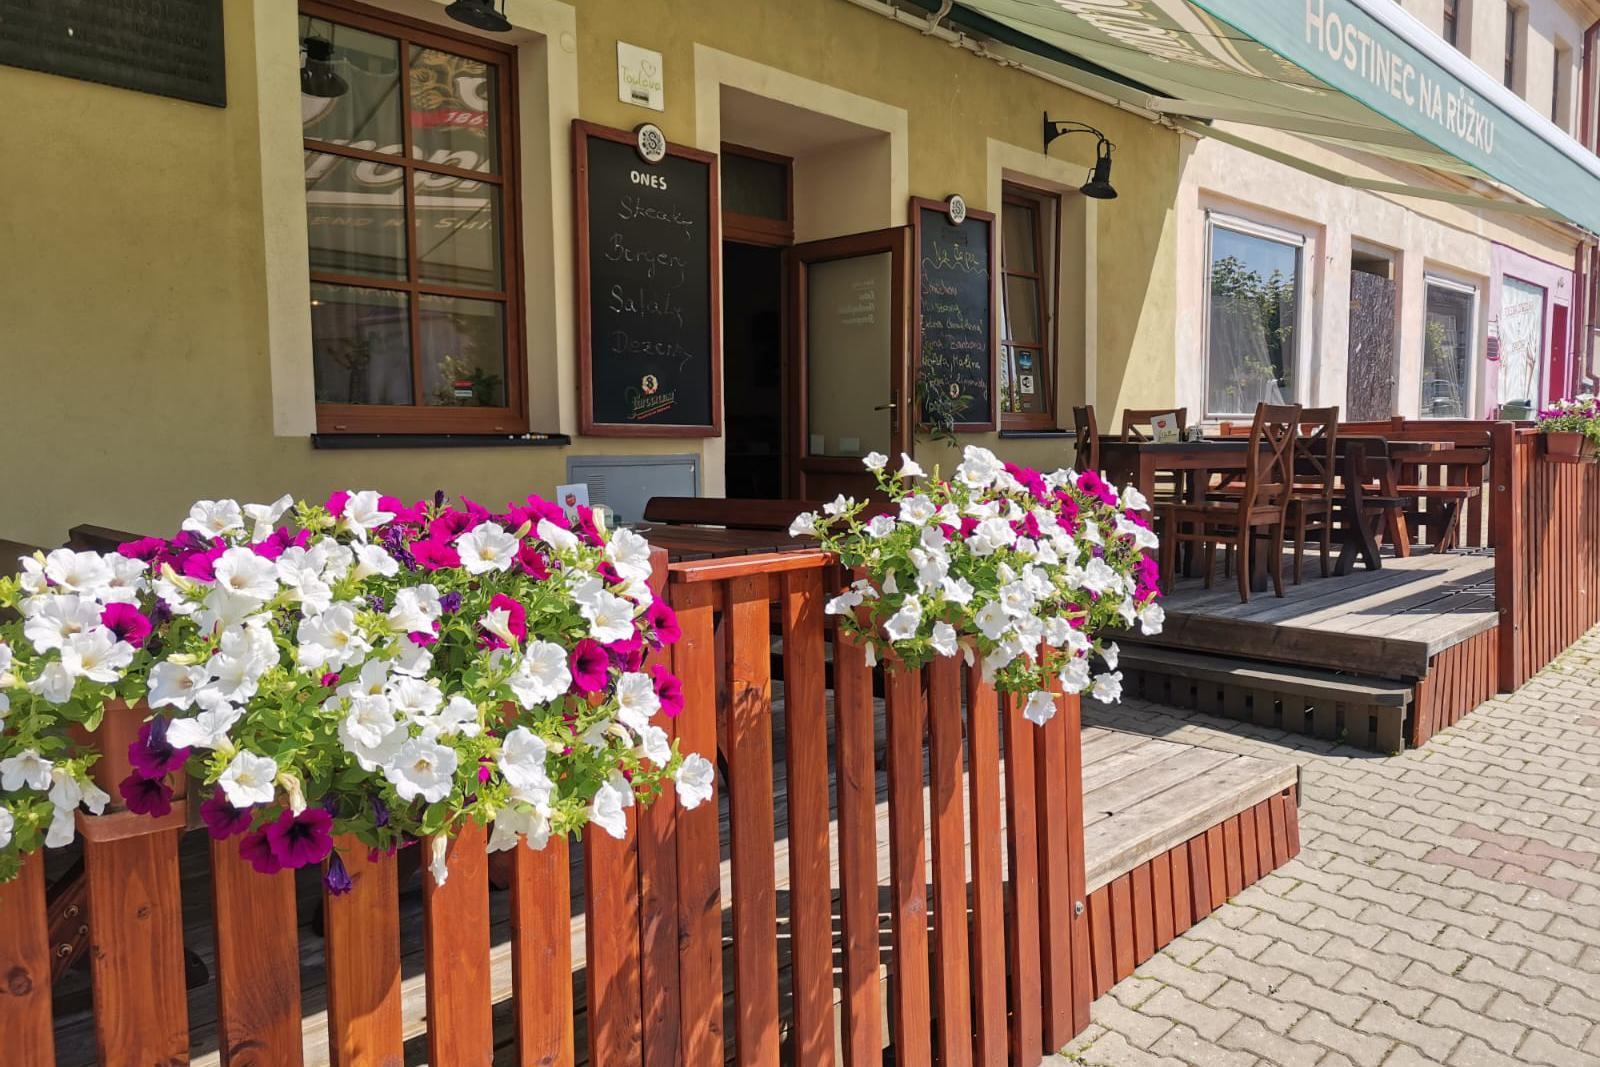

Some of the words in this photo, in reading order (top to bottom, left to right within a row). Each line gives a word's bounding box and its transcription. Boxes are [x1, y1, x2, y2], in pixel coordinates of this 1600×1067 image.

[1305, 0, 1415, 107] HOSTINEC
[1419, 73, 1444, 126] NA
[1446, 87, 1495, 155] RŮŽKU
